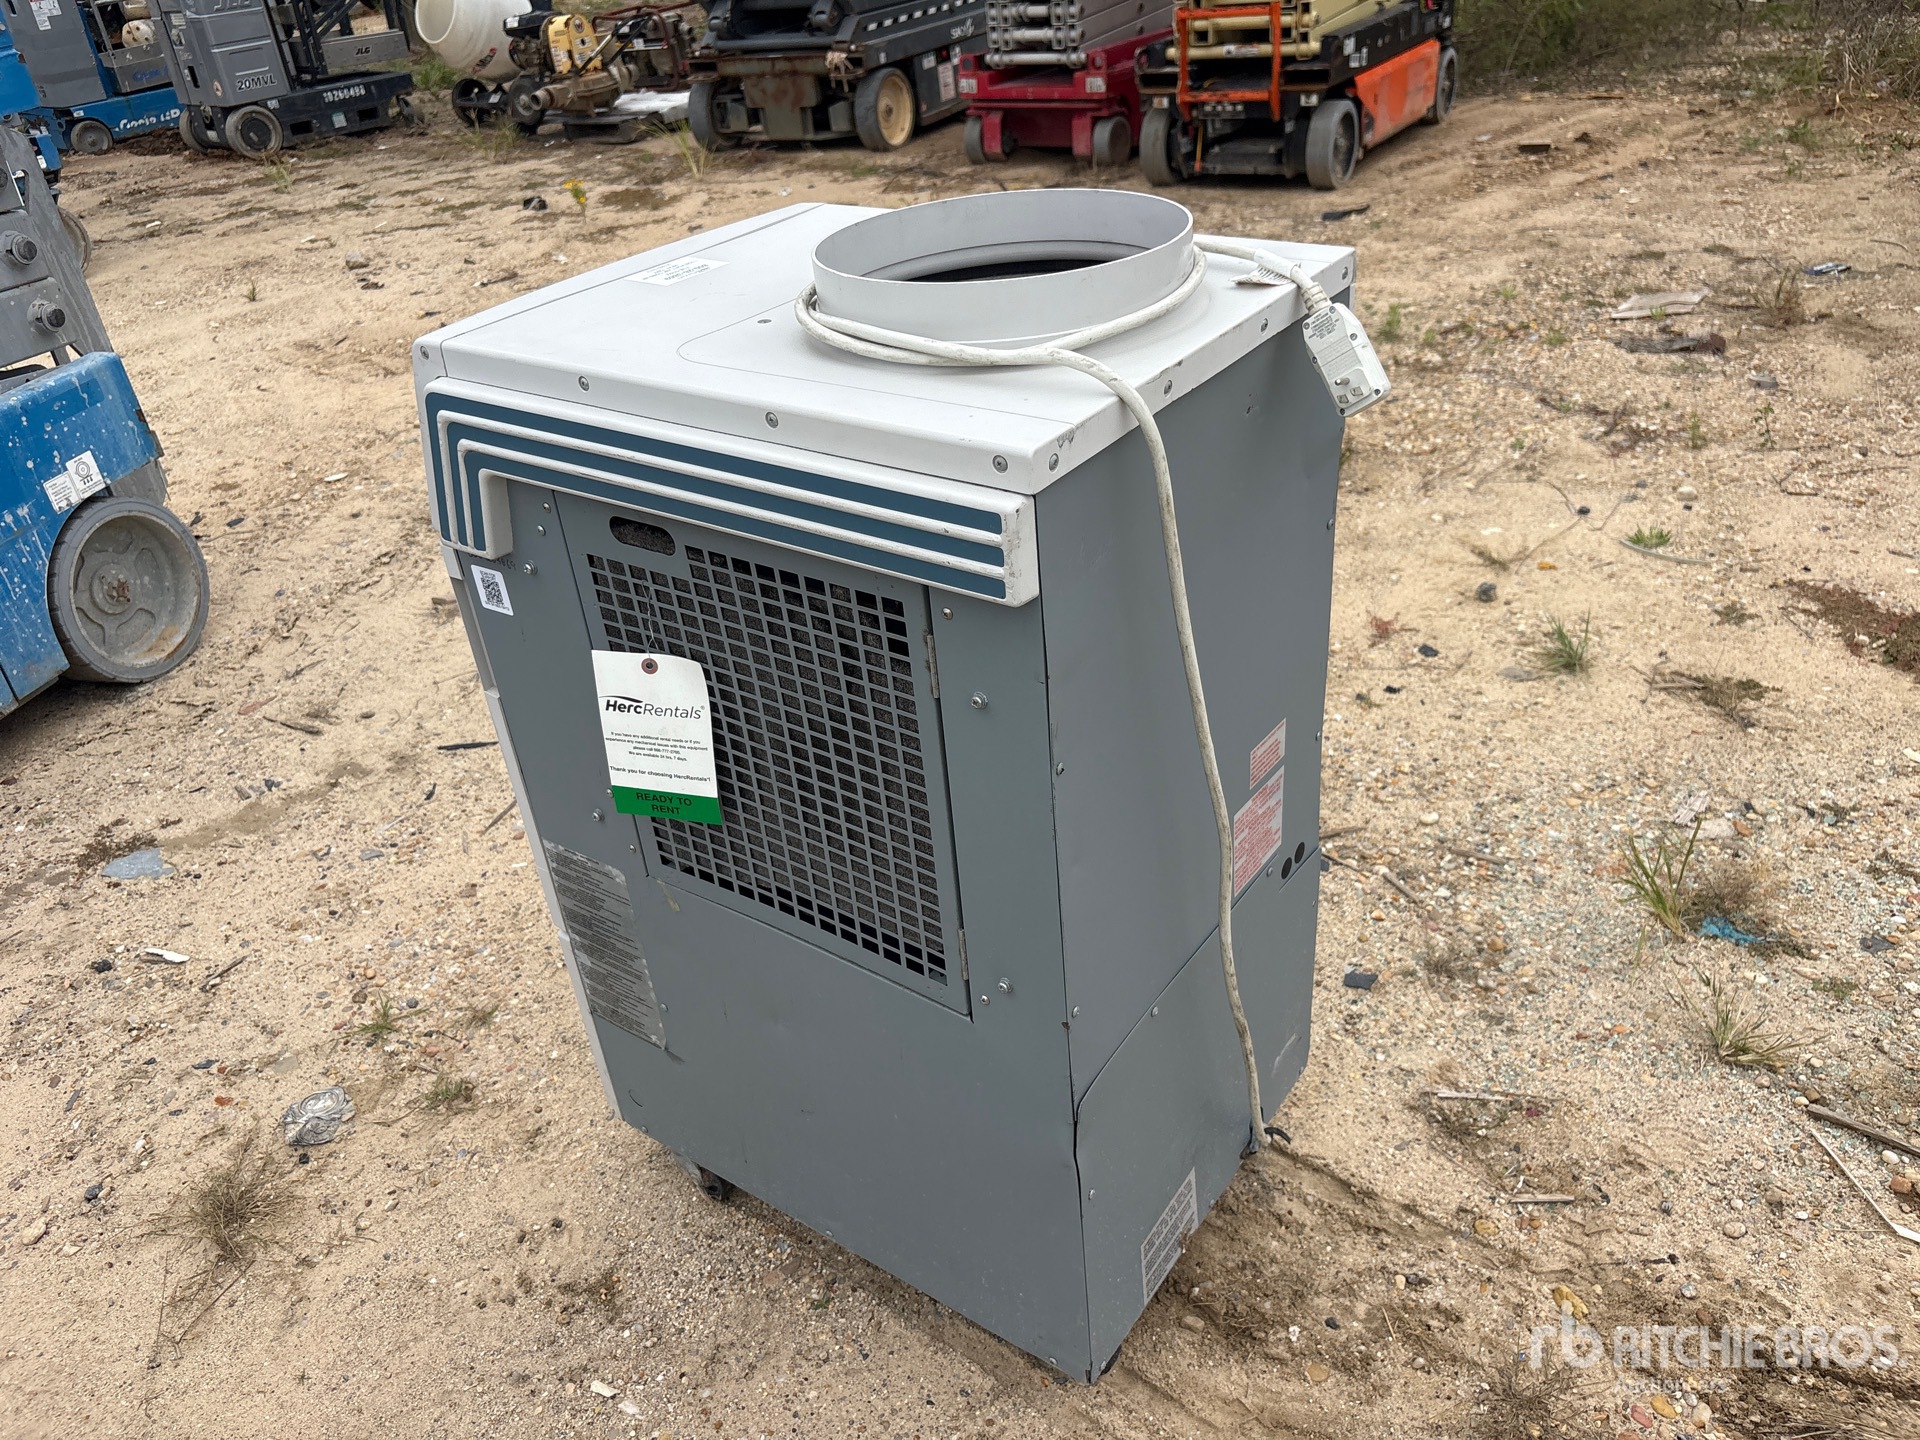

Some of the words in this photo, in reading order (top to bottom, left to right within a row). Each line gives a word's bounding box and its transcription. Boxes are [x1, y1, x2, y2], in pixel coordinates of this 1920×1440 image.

[356, 46, 371, 55] JLG
[237, 74, 277, 92] 20MVL
[636, 792, 673, 804] READY
[677, 797, 692, 806] TO
[652, 804, 680, 814] RENT
